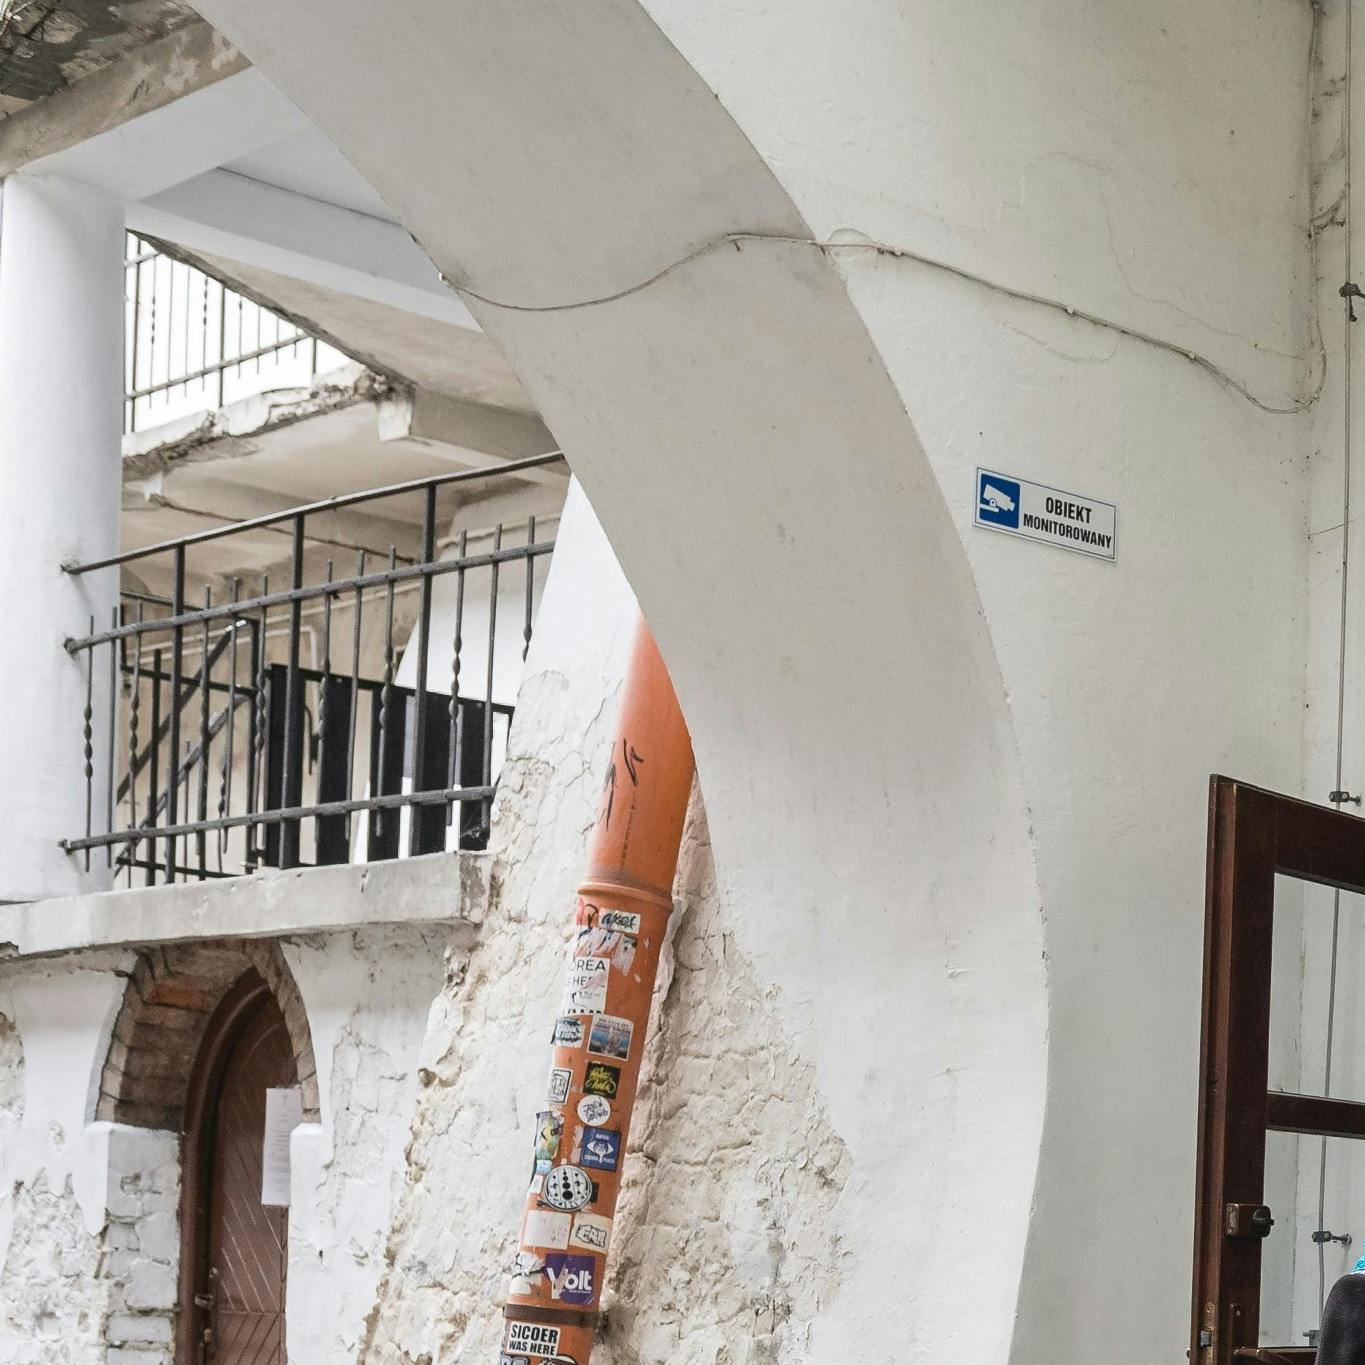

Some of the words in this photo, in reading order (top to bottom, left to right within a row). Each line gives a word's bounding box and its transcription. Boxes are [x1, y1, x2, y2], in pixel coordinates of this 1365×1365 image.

[1045, 497, 1092, 524] OBIEKT
[1023, 513, 1112, 549] MONITOROWANY
[546, 1266, 592, 1291] Volt
[511, 1324, 559, 1344] SICOER
[508, 1340, 528, 1352] WAS
[530, 1342, 556, 1356] HERE
